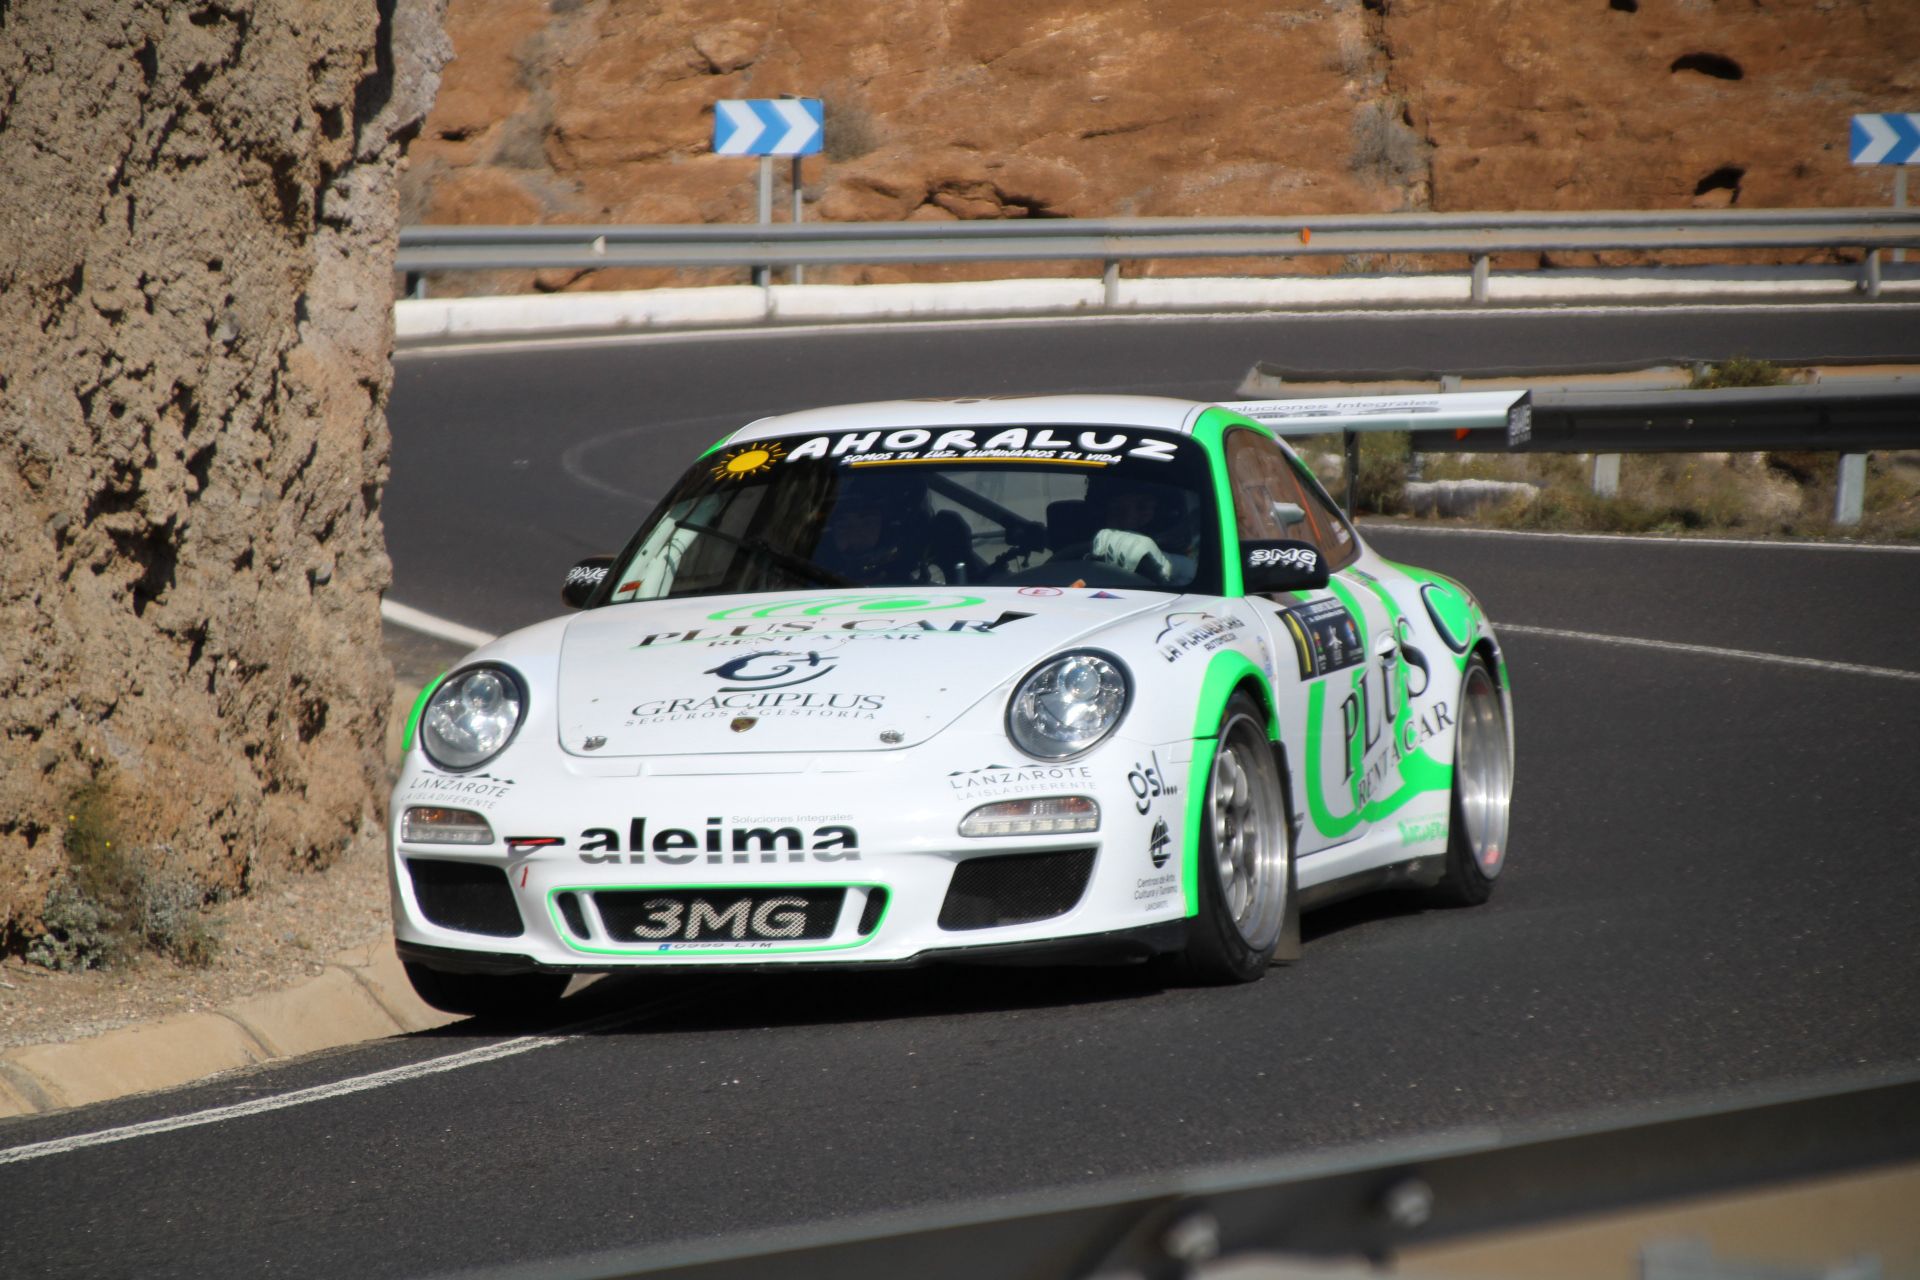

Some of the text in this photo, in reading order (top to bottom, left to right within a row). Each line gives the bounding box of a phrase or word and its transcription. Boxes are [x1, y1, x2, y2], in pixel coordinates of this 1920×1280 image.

[1231, 399, 1440, 413] oluciones Integrales
[785, 427, 1179, 464] AHORALUZ
[840, 452, 894, 466] SOMOS
[896, 451, 919, 460] TU
[1059, 451, 1082, 460] TU
[1084, 452, 1123, 465] VIDA
[639, 613, 1020, 647] PLUS CAR
[632, 692, 886, 717] GRACIPLUS
[624, 709, 729, 727] SEGUROS
[1403, 701, 1456, 752] CAR
[409, 777, 511, 798] LANZAROTE
[950, 766, 1093, 789] LANZAROTE
[731, 811, 854, 824] Soluciones Integrales
[579, 816, 862, 865] aleima
[633, 896, 809, 941] 3MG
